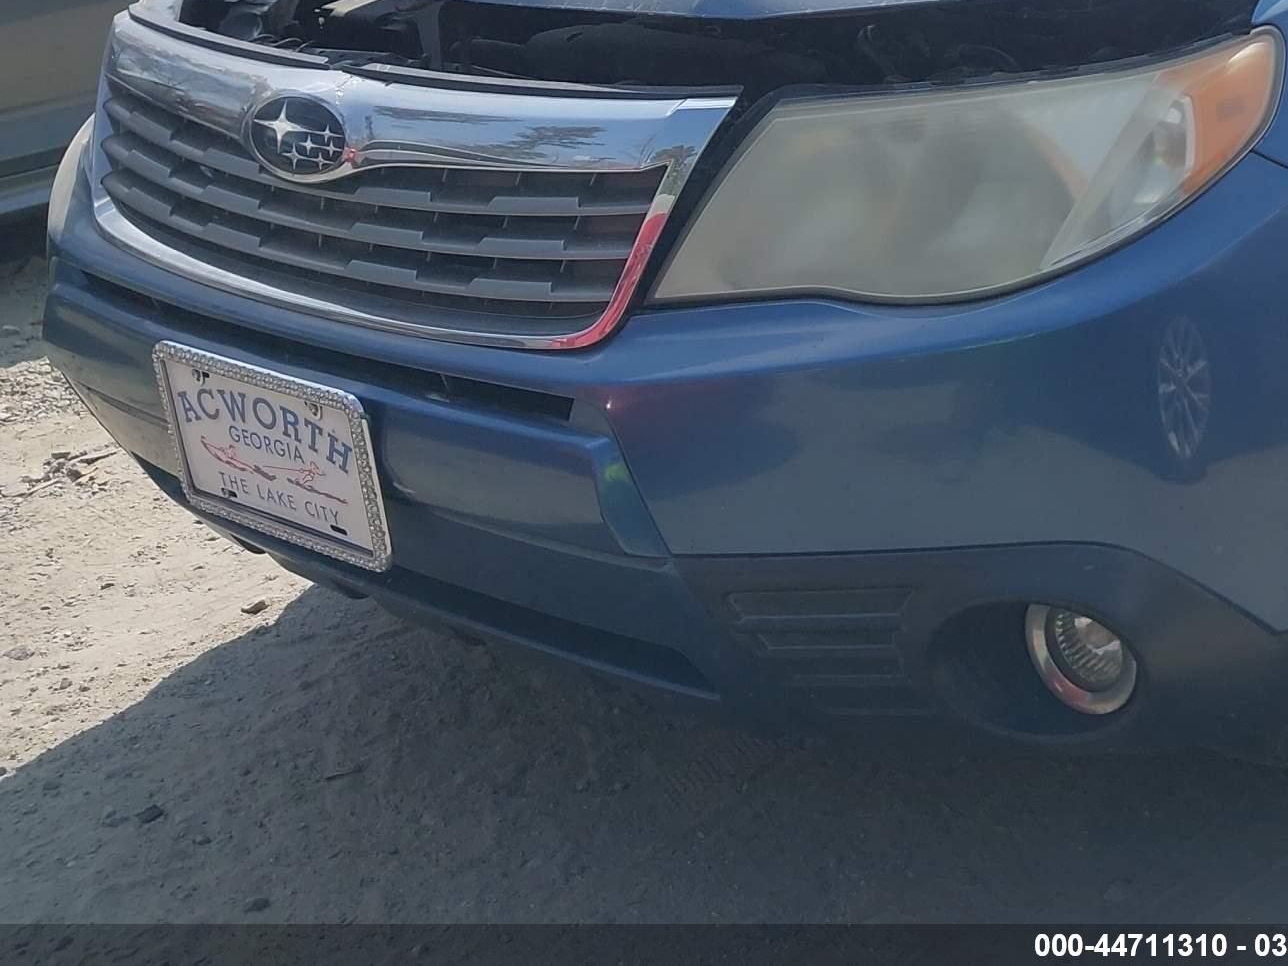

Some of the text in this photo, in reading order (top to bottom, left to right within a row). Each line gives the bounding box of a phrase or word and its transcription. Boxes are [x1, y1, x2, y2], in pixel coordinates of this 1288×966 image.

[177, 388, 353, 475] ACWORTH
[228, 425, 306, 464] GEORGIA
[218, 471, 341, 526] THE LAKE CITY
